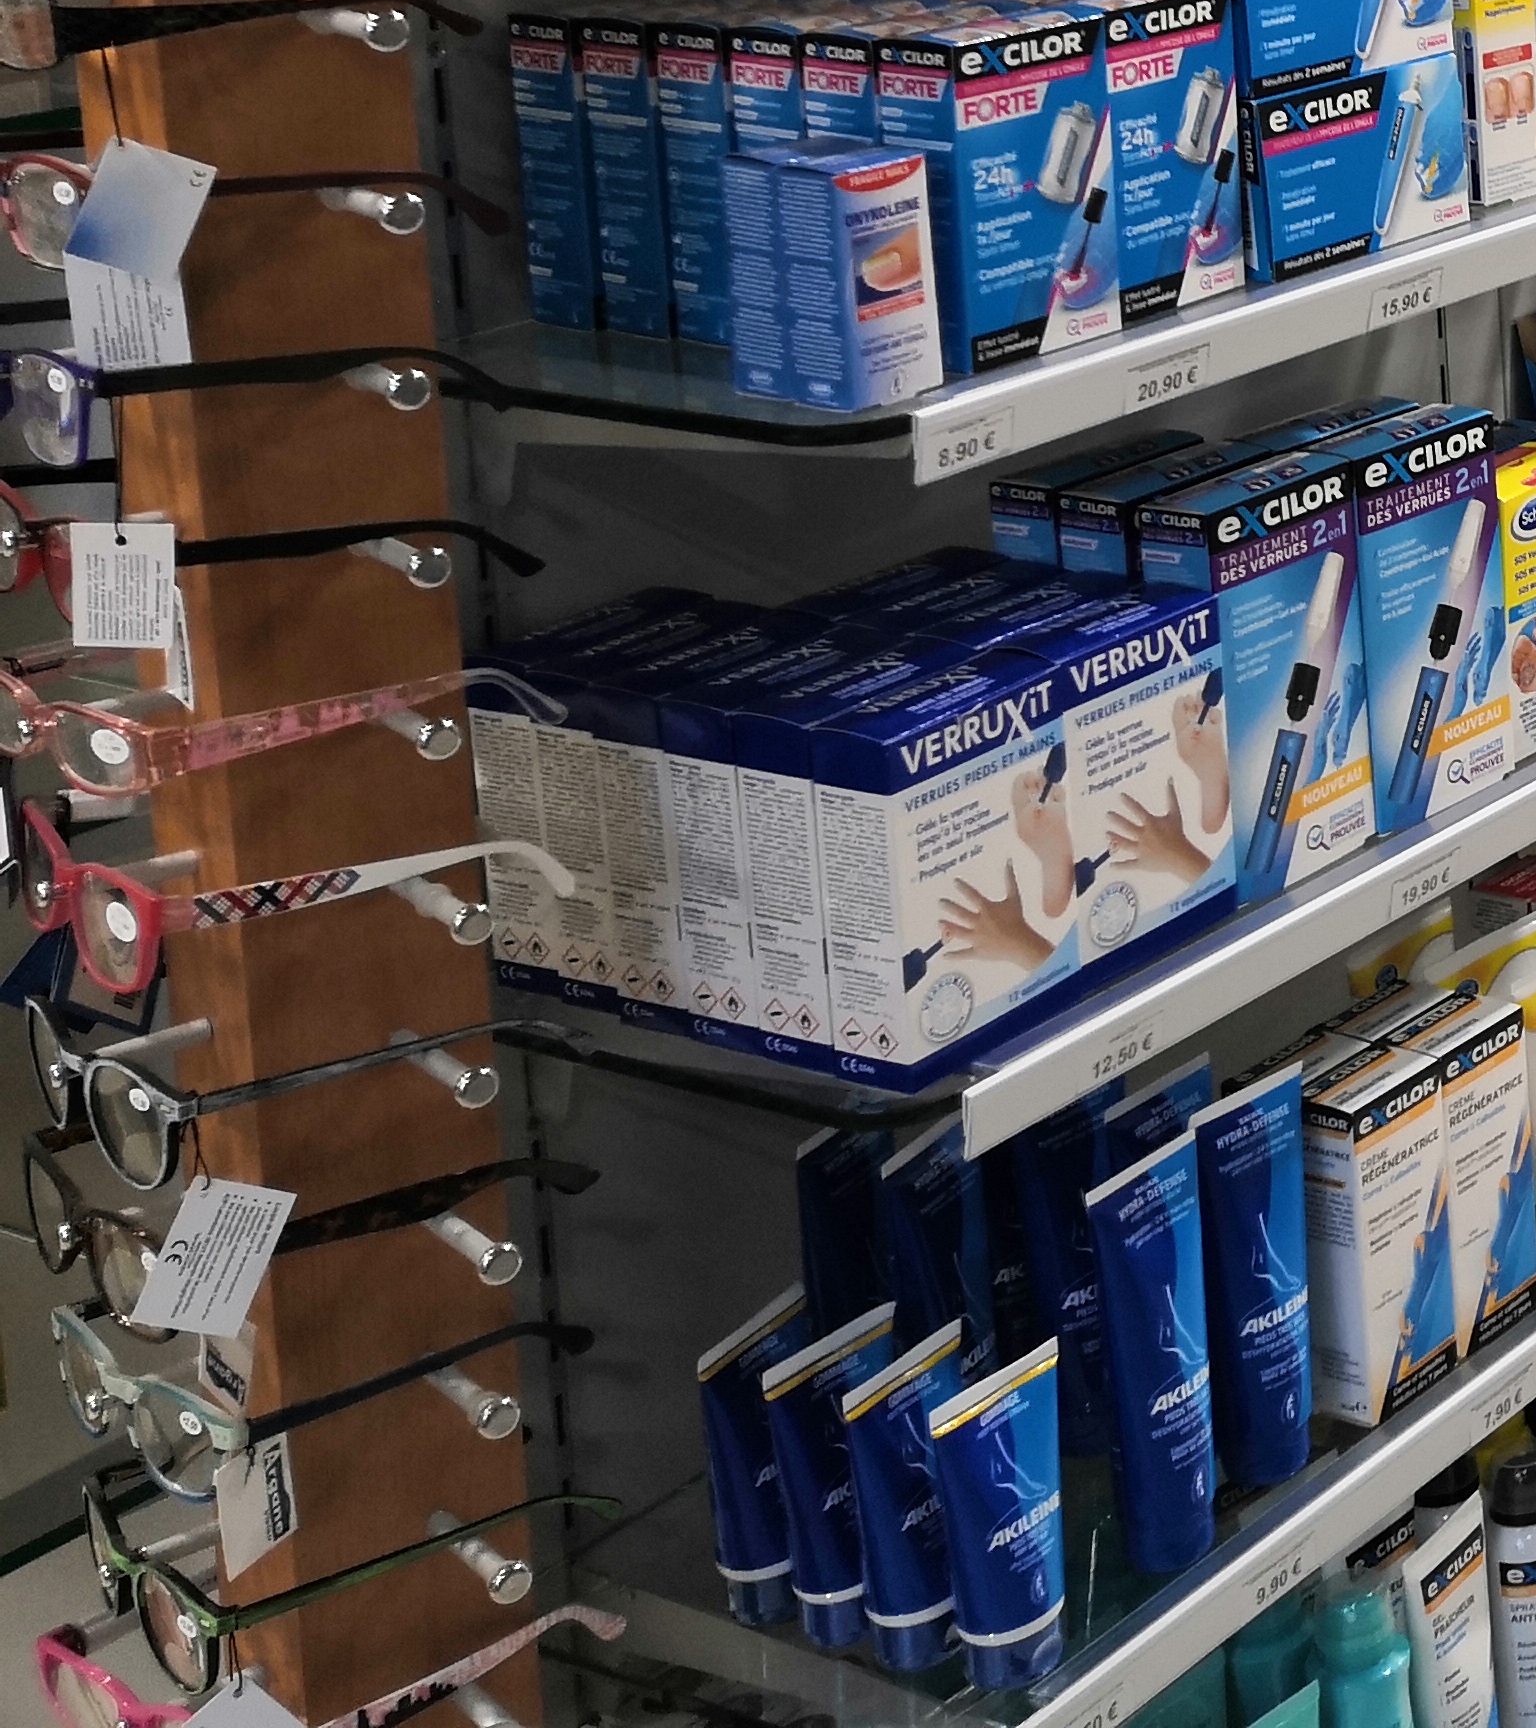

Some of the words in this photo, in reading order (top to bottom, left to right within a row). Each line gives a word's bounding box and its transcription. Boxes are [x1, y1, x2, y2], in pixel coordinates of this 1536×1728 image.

[1109, 1, 1215, 42] eXCILOR
[881, 46, 946, 68] eXCILOR
[960, 32, 1084, 76] eXCILOR
[1111, 54, 1174, 86] FORTE
[733, 65, 785, 89] FORTE
[805, 72, 861, 94] FORTE
[881, 76, 939, 99] FORTE
[962, 88, 1039, 126] FORTE
[1268, 87, 1373, 131] eXCILOR
[1121, 128, 1155, 148] 24h
[973, 166, 1014, 190] 24h
[1380, 294, 1419, 319] 15,90
[1418, 287, 1432, 310] €
[1136, 371, 1182, 402] 20,90
[1181, 364, 1200, 389] €
[937, 437, 974, 468] 8,90
[975, 430, 996, 459] €
[1365, 424, 1490, 489] eXCILOR
[1217, 474, 1346, 544] eXCILOR
[1367, 509, 1393, 528] DES
[1395, 488, 1451, 520] VERRUES
[1221, 565, 1246, 586] DES
[1247, 540, 1308, 575] VERRUES
[1069, 609, 1211, 696] VERRUXiT
[901, 680, 1054, 774] VERRUXiT
[1442, 704, 1503, 741] NOUVEAU
[1302, 764, 1363, 807] NOUVEAU
[1401, 874, 1442, 907] 19,90
[1441, 865, 1452, 885] €
[1091, 1038, 1141, 1078] 12,50
[1141, 1030, 1153, 1053] €
[1445, 1020, 1522, 1077] eXCILOR
[1359, 1074, 1438, 1136] eXCILOR
[1449, 1073, 1524, 1129] RÉGÉNÉRATRICE
[1362, 1128, 1439, 1188] RÉGÉNÉRATRICE
[1483, 1393, 1513, 1429] 7,90
[1511, 1387, 1523, 1407] €
[1426, 1535, 1486, 1602] eXCILOR
